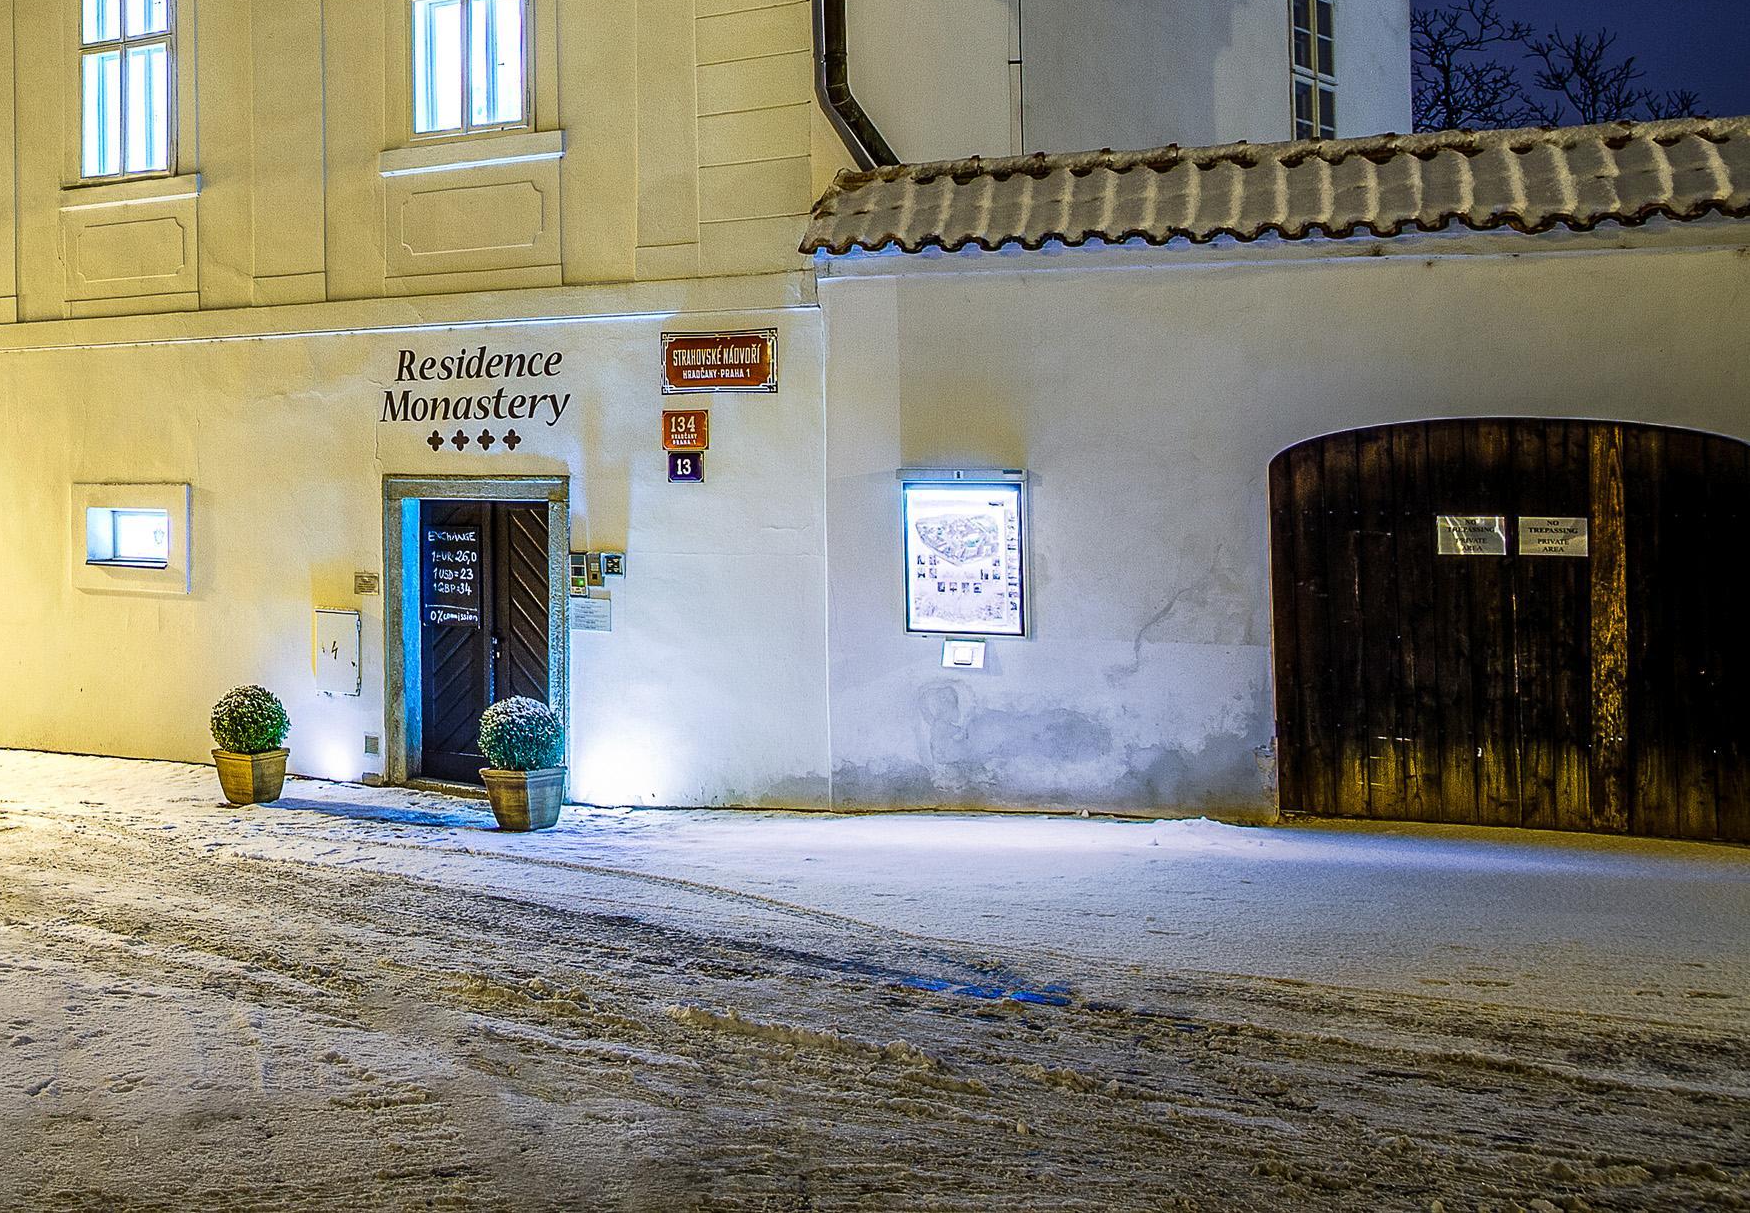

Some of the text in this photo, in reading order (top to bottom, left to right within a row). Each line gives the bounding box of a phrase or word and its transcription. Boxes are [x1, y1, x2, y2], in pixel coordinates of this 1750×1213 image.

[673, 343, 761, 366] STRAHOVSKÉ NÁDVOŘÍ
[394, 346, 563, 381] Residence
[746, 368, 750, 378] 1
[379, 387, 571, 426] Monastery
[670, 416, 696, 433] 134
[676, 458, 691, 475] 13
[428, 531, 476, 542] EXCHANGE
